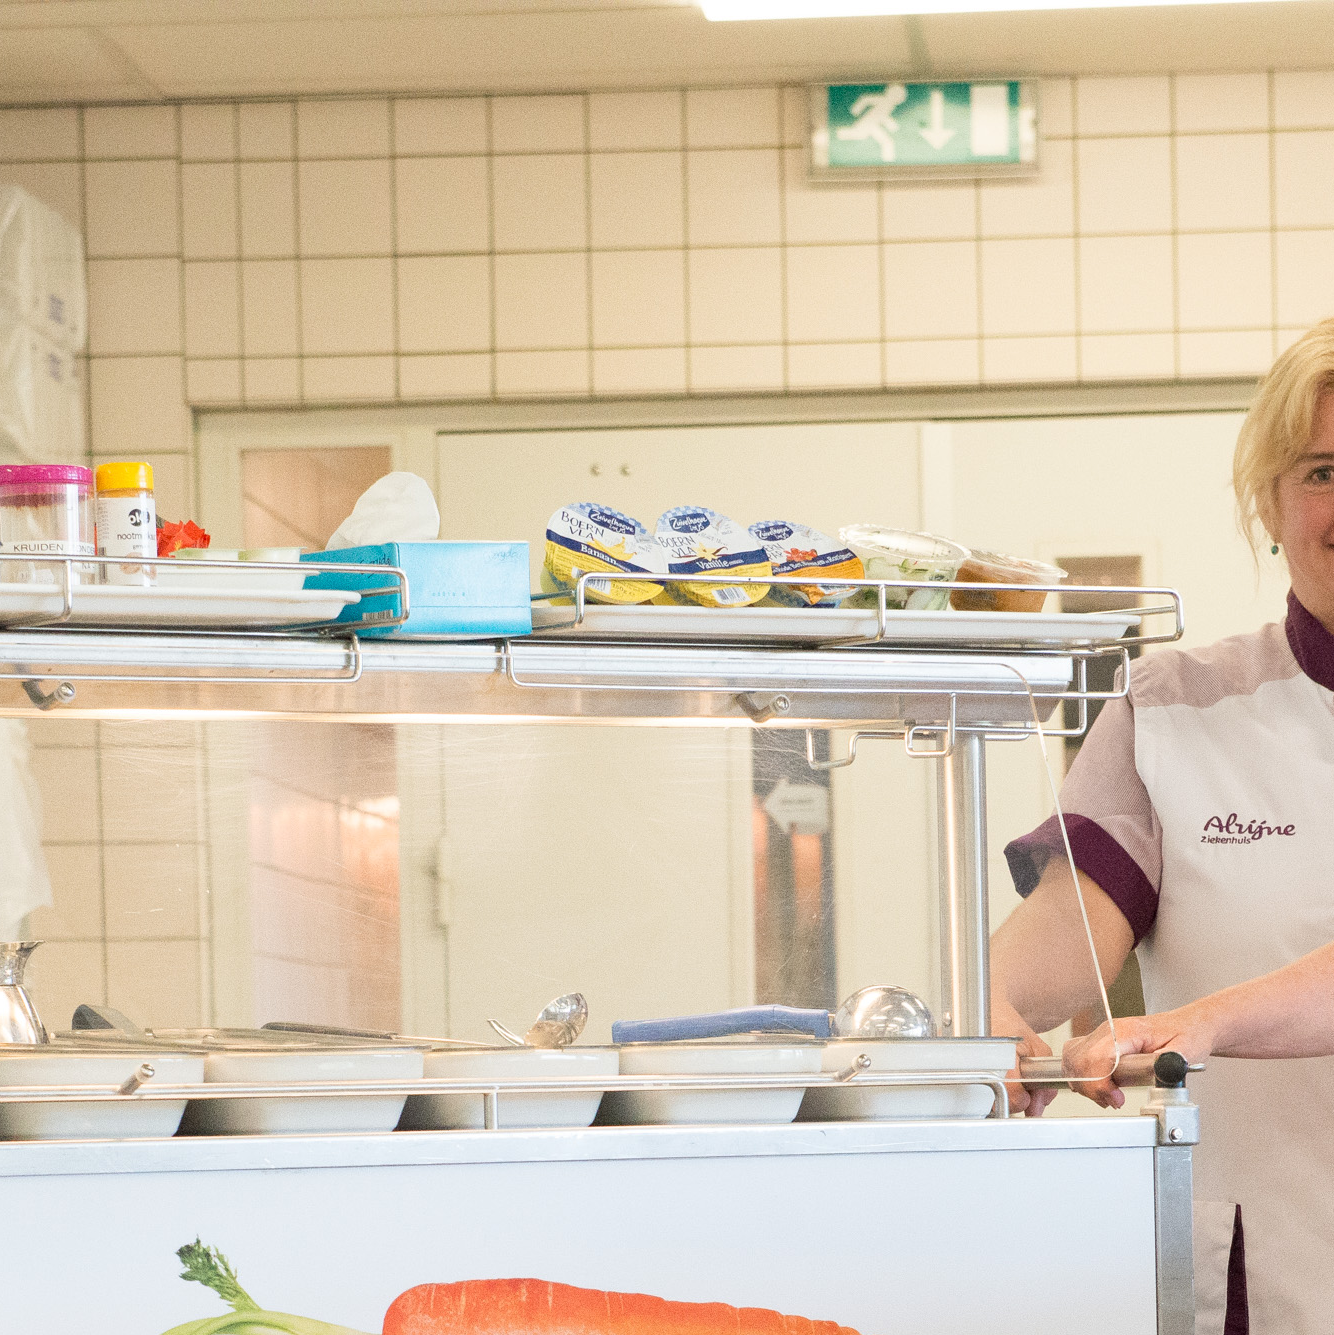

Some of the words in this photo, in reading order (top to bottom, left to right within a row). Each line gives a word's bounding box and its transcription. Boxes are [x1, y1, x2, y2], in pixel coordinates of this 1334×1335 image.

[569, 525, 594, 541] VLA
[13, 543, 64, 552] KRUIDEN
[580, 543, 617, 564] Banaan
[696, 558, 729, 570] Vanille
[1203, 812, 1296, 841] Alrijne
